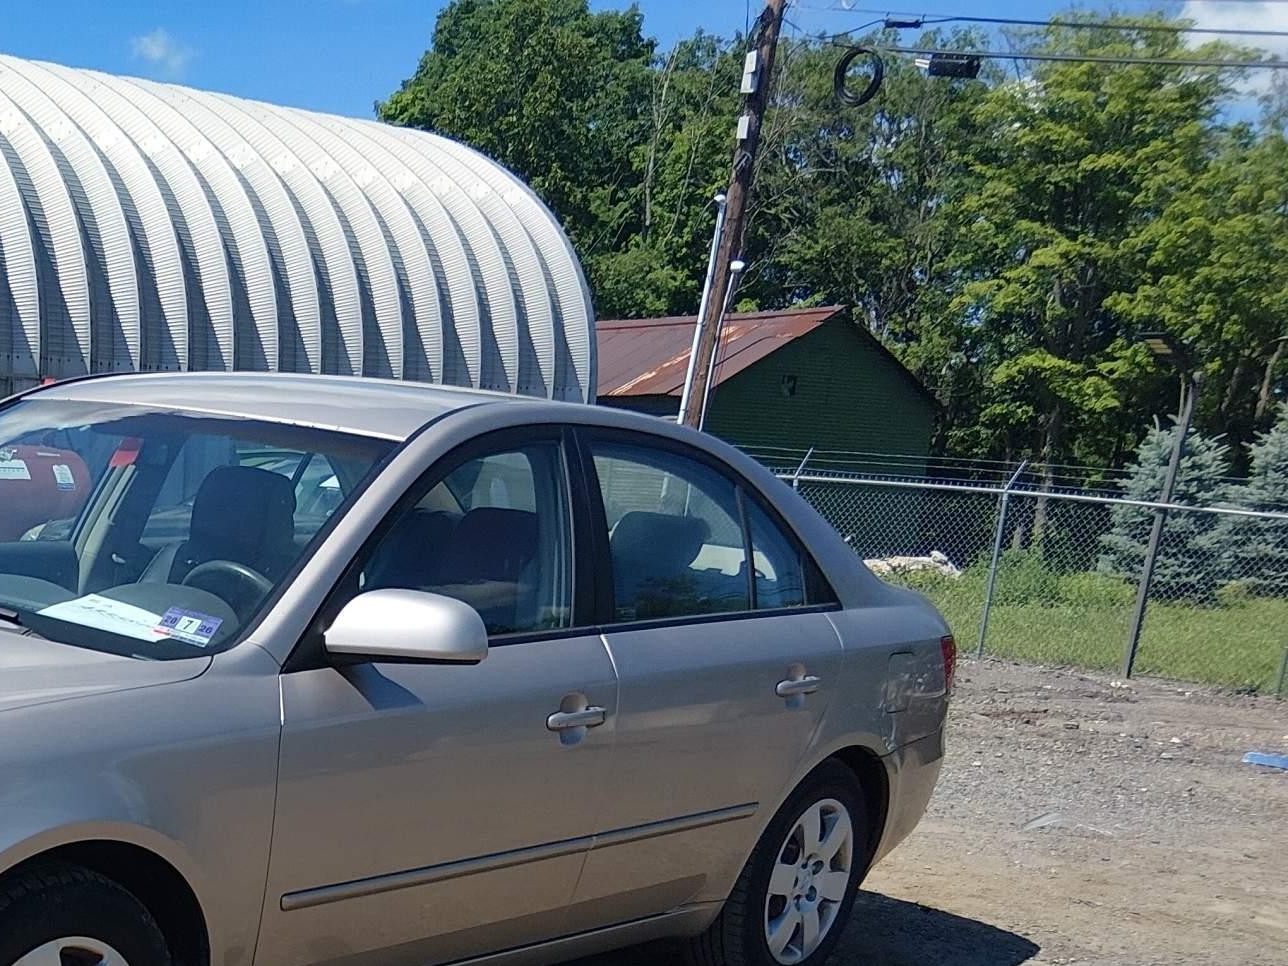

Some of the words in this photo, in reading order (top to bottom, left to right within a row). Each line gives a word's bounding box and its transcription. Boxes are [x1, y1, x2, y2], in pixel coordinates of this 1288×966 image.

[164, 615, 178, 625] 20
[183, 619, 194, 630] 7
[199, 624, 213, 634] 26
